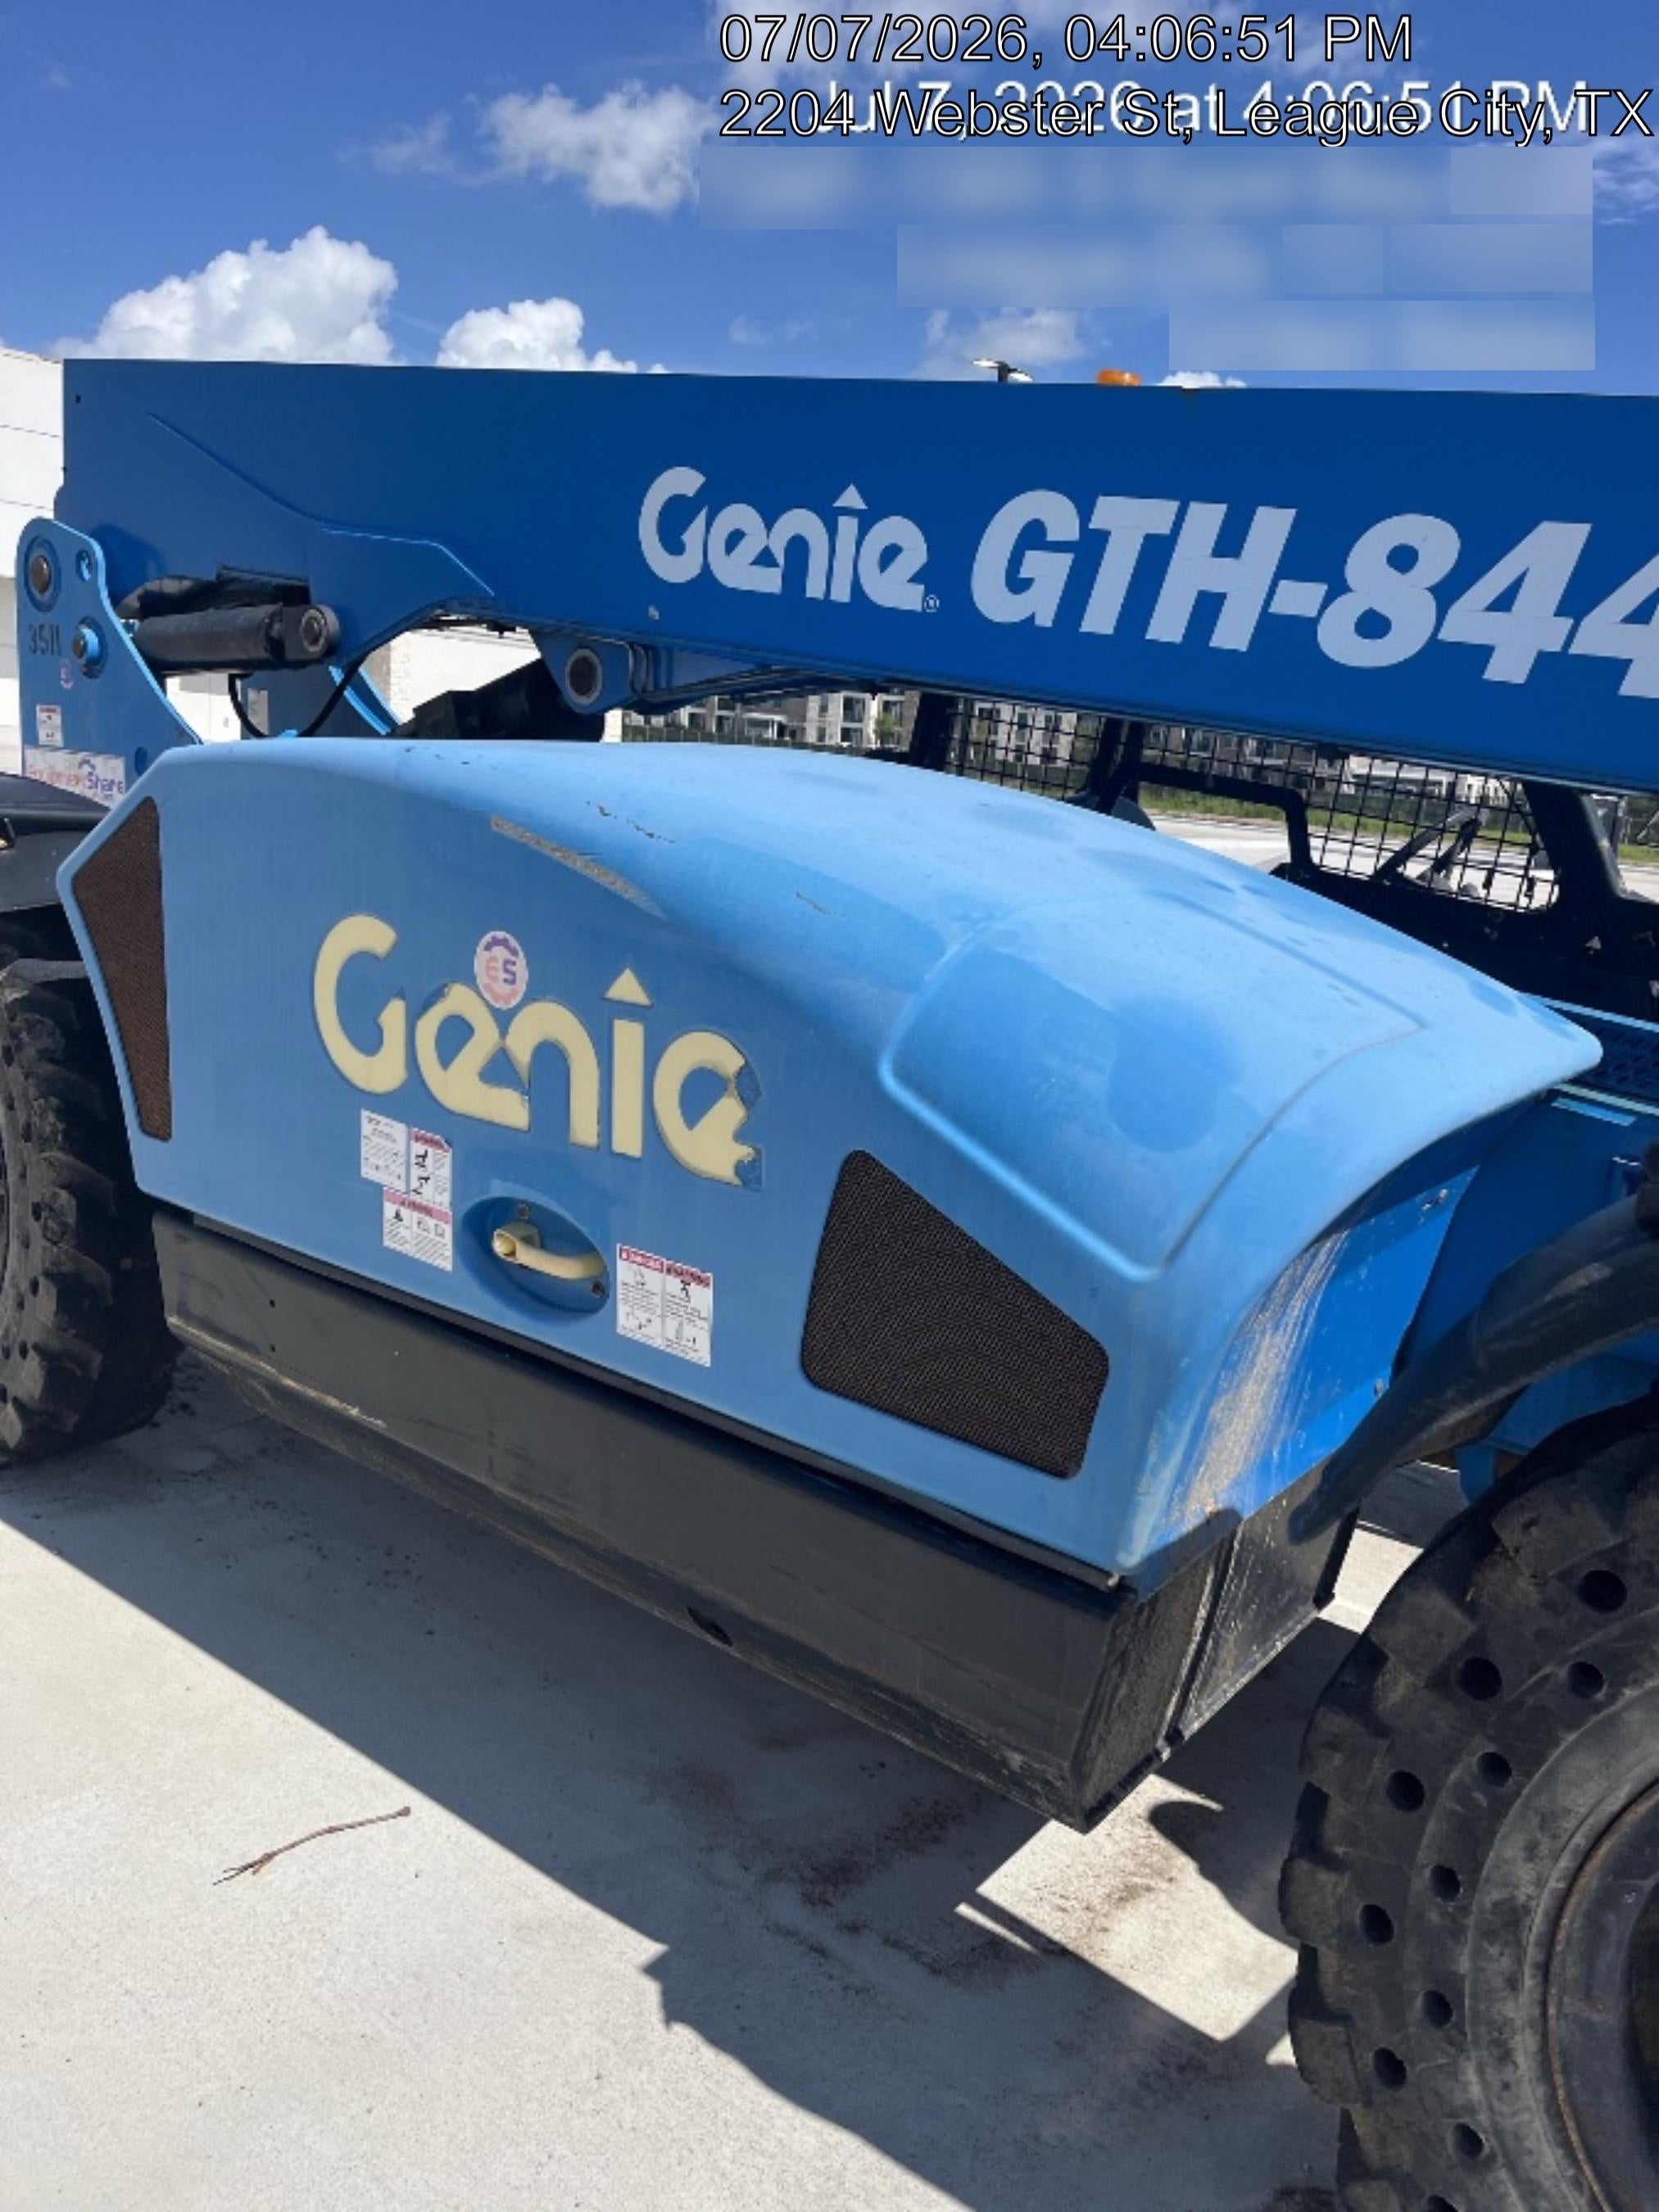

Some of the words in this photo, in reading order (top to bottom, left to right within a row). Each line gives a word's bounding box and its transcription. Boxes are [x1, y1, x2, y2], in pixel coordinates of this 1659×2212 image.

[638, 466, 928, 613] Genie
[971, 488, 1659, 700] GTH-844
[314, 913, 755, 1190] Genie
